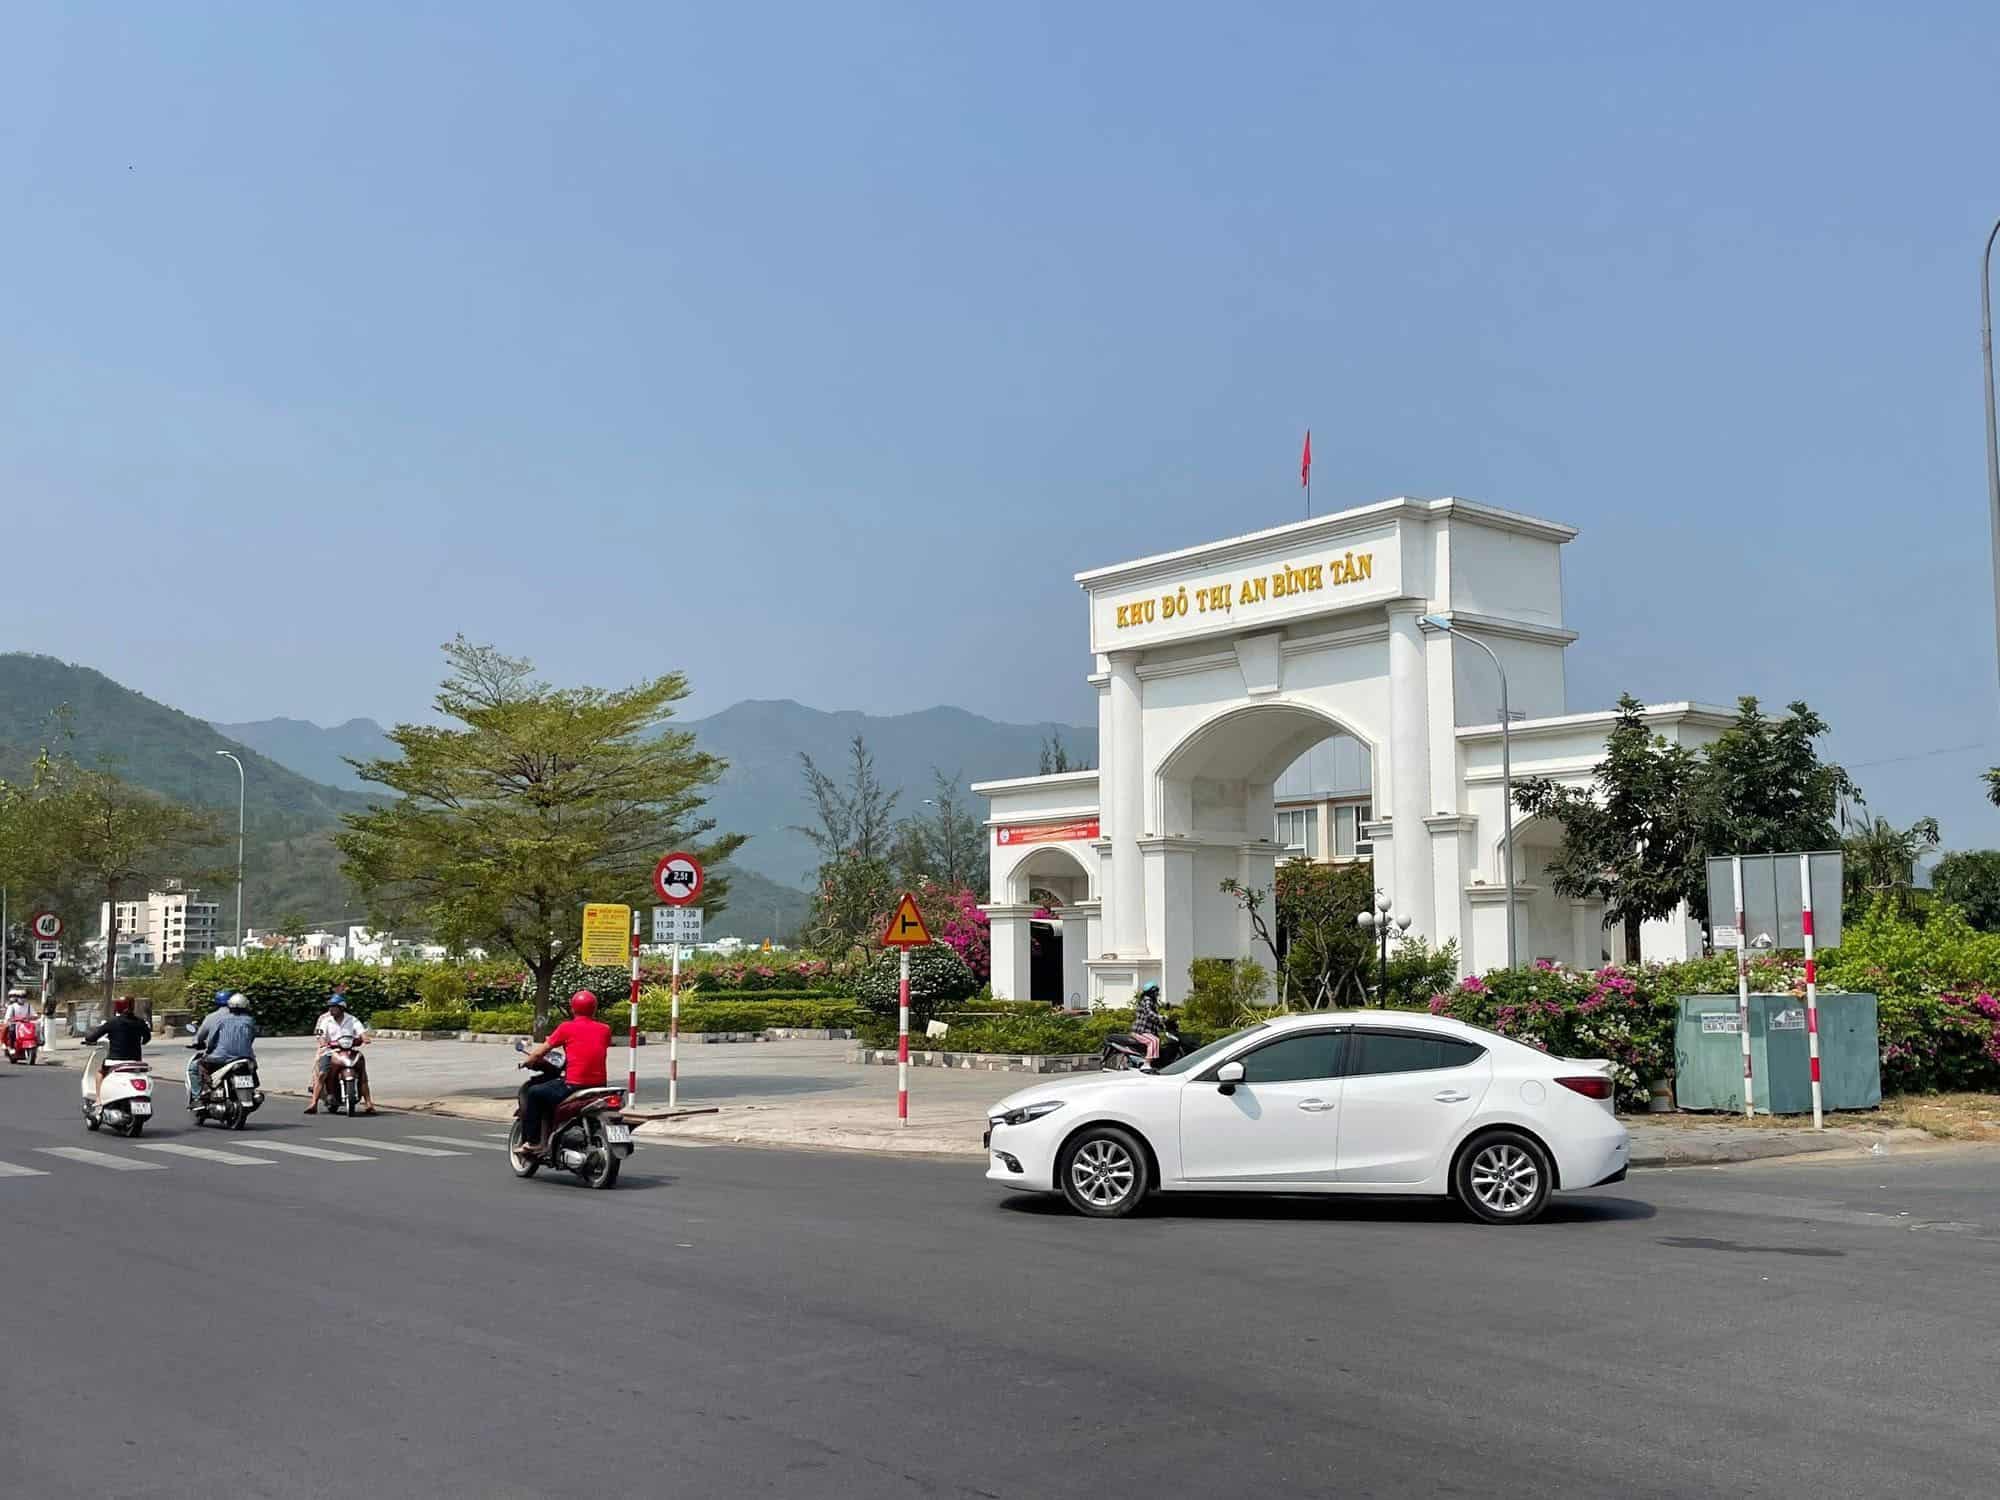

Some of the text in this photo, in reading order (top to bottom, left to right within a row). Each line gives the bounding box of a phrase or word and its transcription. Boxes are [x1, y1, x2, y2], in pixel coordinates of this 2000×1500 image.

[1116, 551, 1373, 627] KHU ĐÔ THỊ AN BÌNH TÂN
[41, 919, 55, 932] 40
